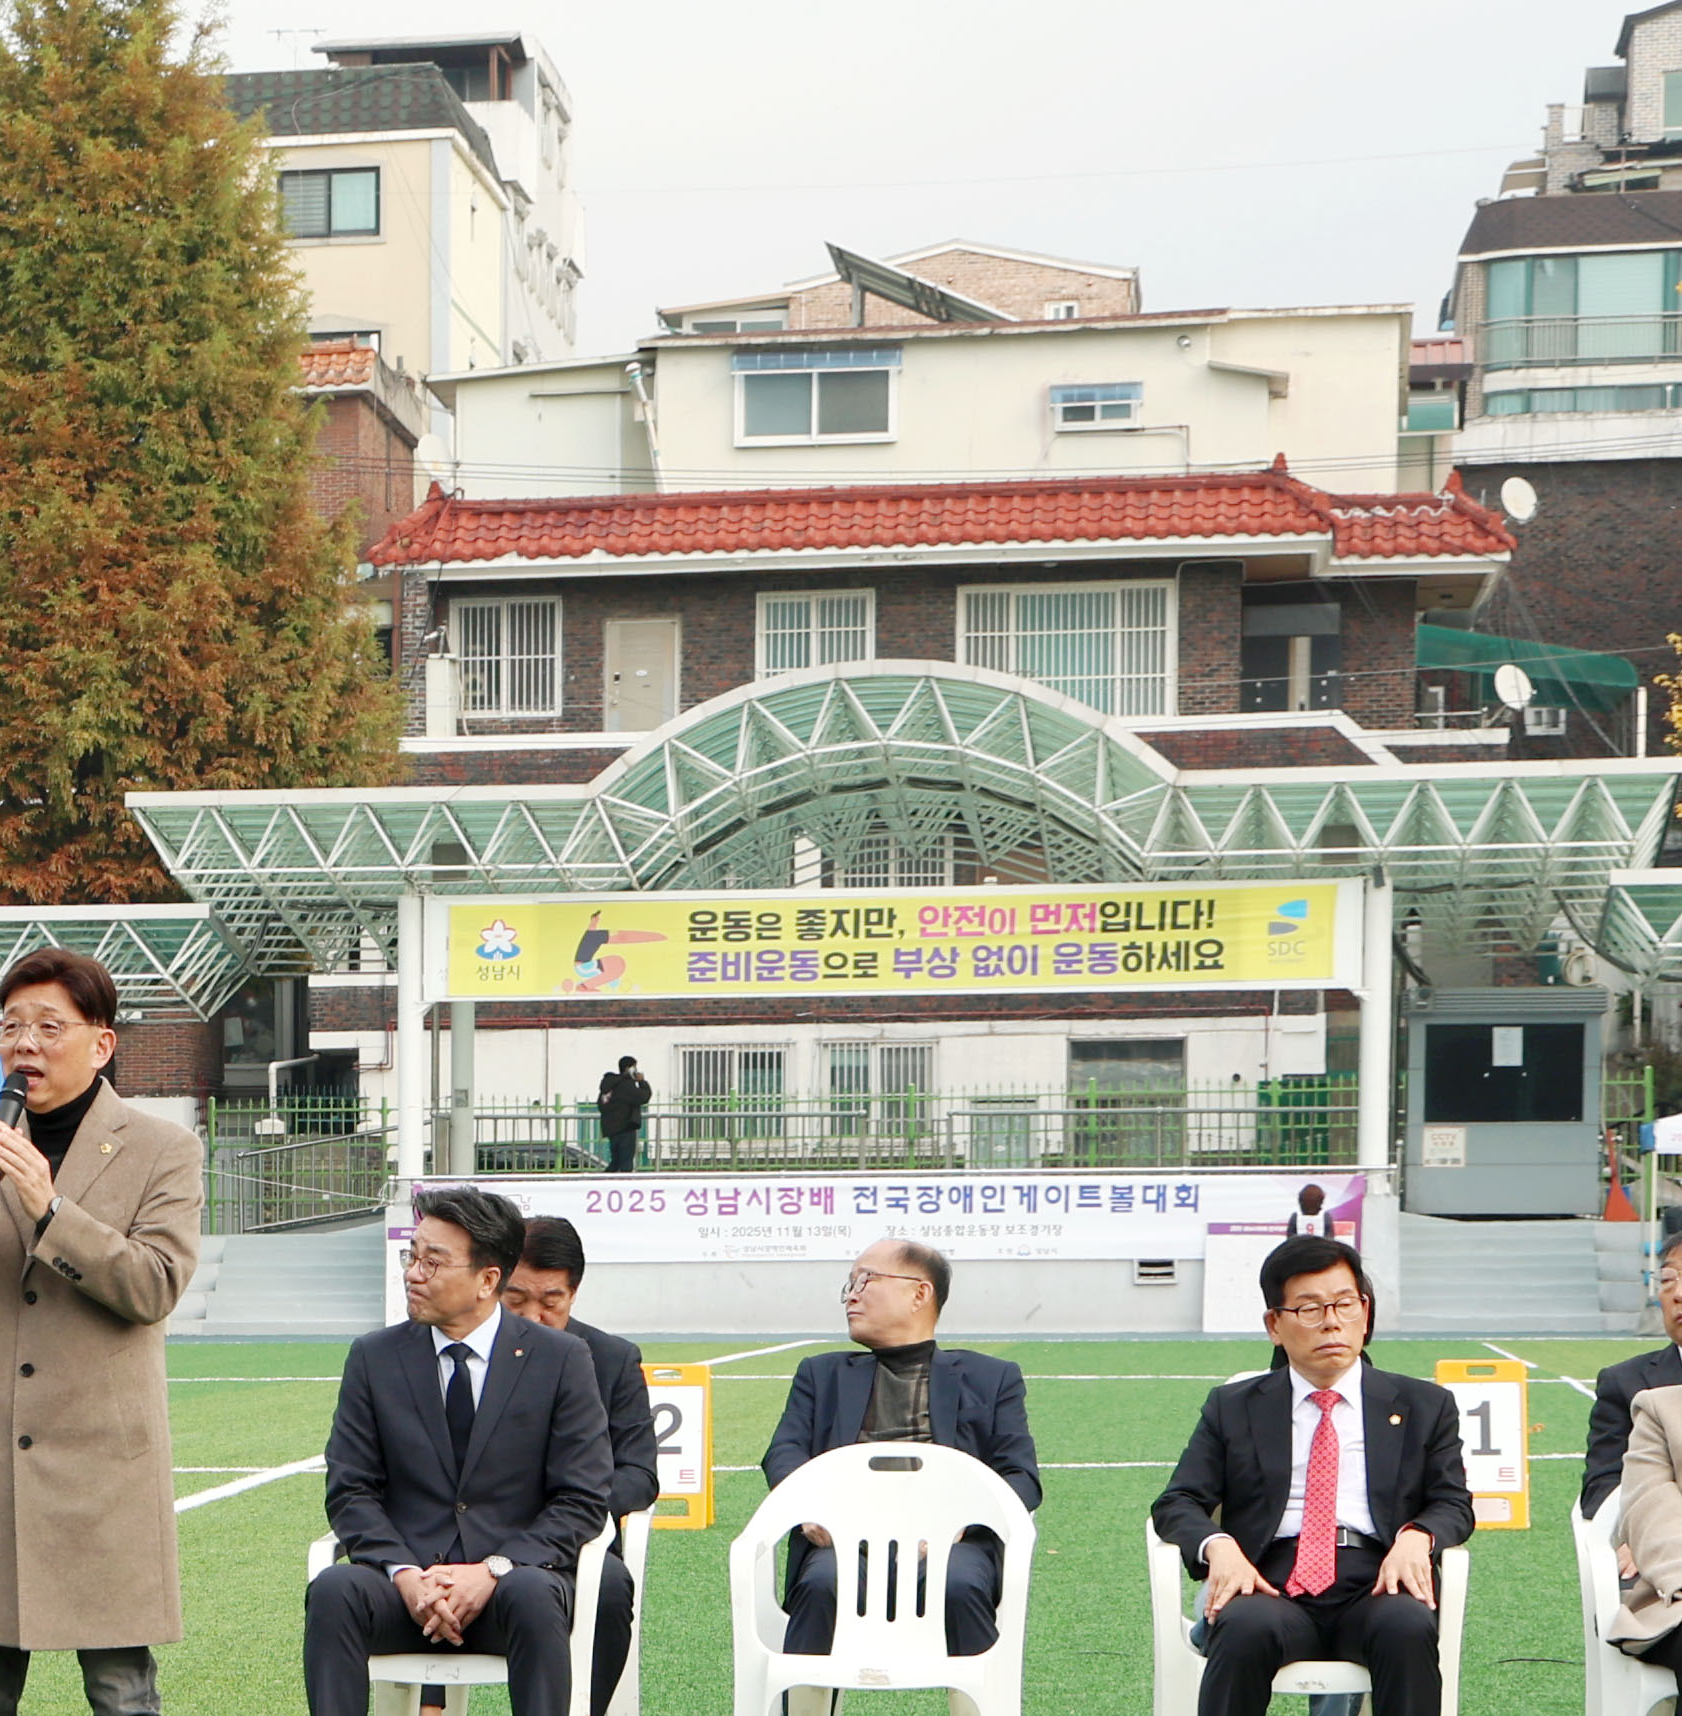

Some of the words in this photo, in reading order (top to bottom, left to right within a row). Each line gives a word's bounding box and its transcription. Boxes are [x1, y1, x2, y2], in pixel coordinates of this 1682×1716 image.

[687, 909, 783, 943] 운동은
[795, 905, 905, 941] 좋지만,
[917, 904, 1016, 938] 안전이
[1029, 899, 1216, 935] 먼저입니다!
[687, 949, 879, 983] 준비운동으로
[892, 945, 959, 979] 부상
[972, 943, 1039, 979] 없이
[1052, 938, 1225, 975] 운동하세요
[1267, 941, 1306, 956] SDC
[475, 964, 521, 982] 성남시
[585, 1188, 667, 1214] 2025
[683, 1185, 836, 1216] 성남시장배
[852, 1182, 1201, 1216] 전국장애인게이트볼대회
[698, 1225, 720, 1238] 일시
[731, 1224, 772, 1238] 2025년
[776, 1224, 803, 1238] 11월
[884, 1224, 909, 1238] 장소
[650, 1403, 682, 1454] 2
[1466, 1400, 1502, 1456] 1
